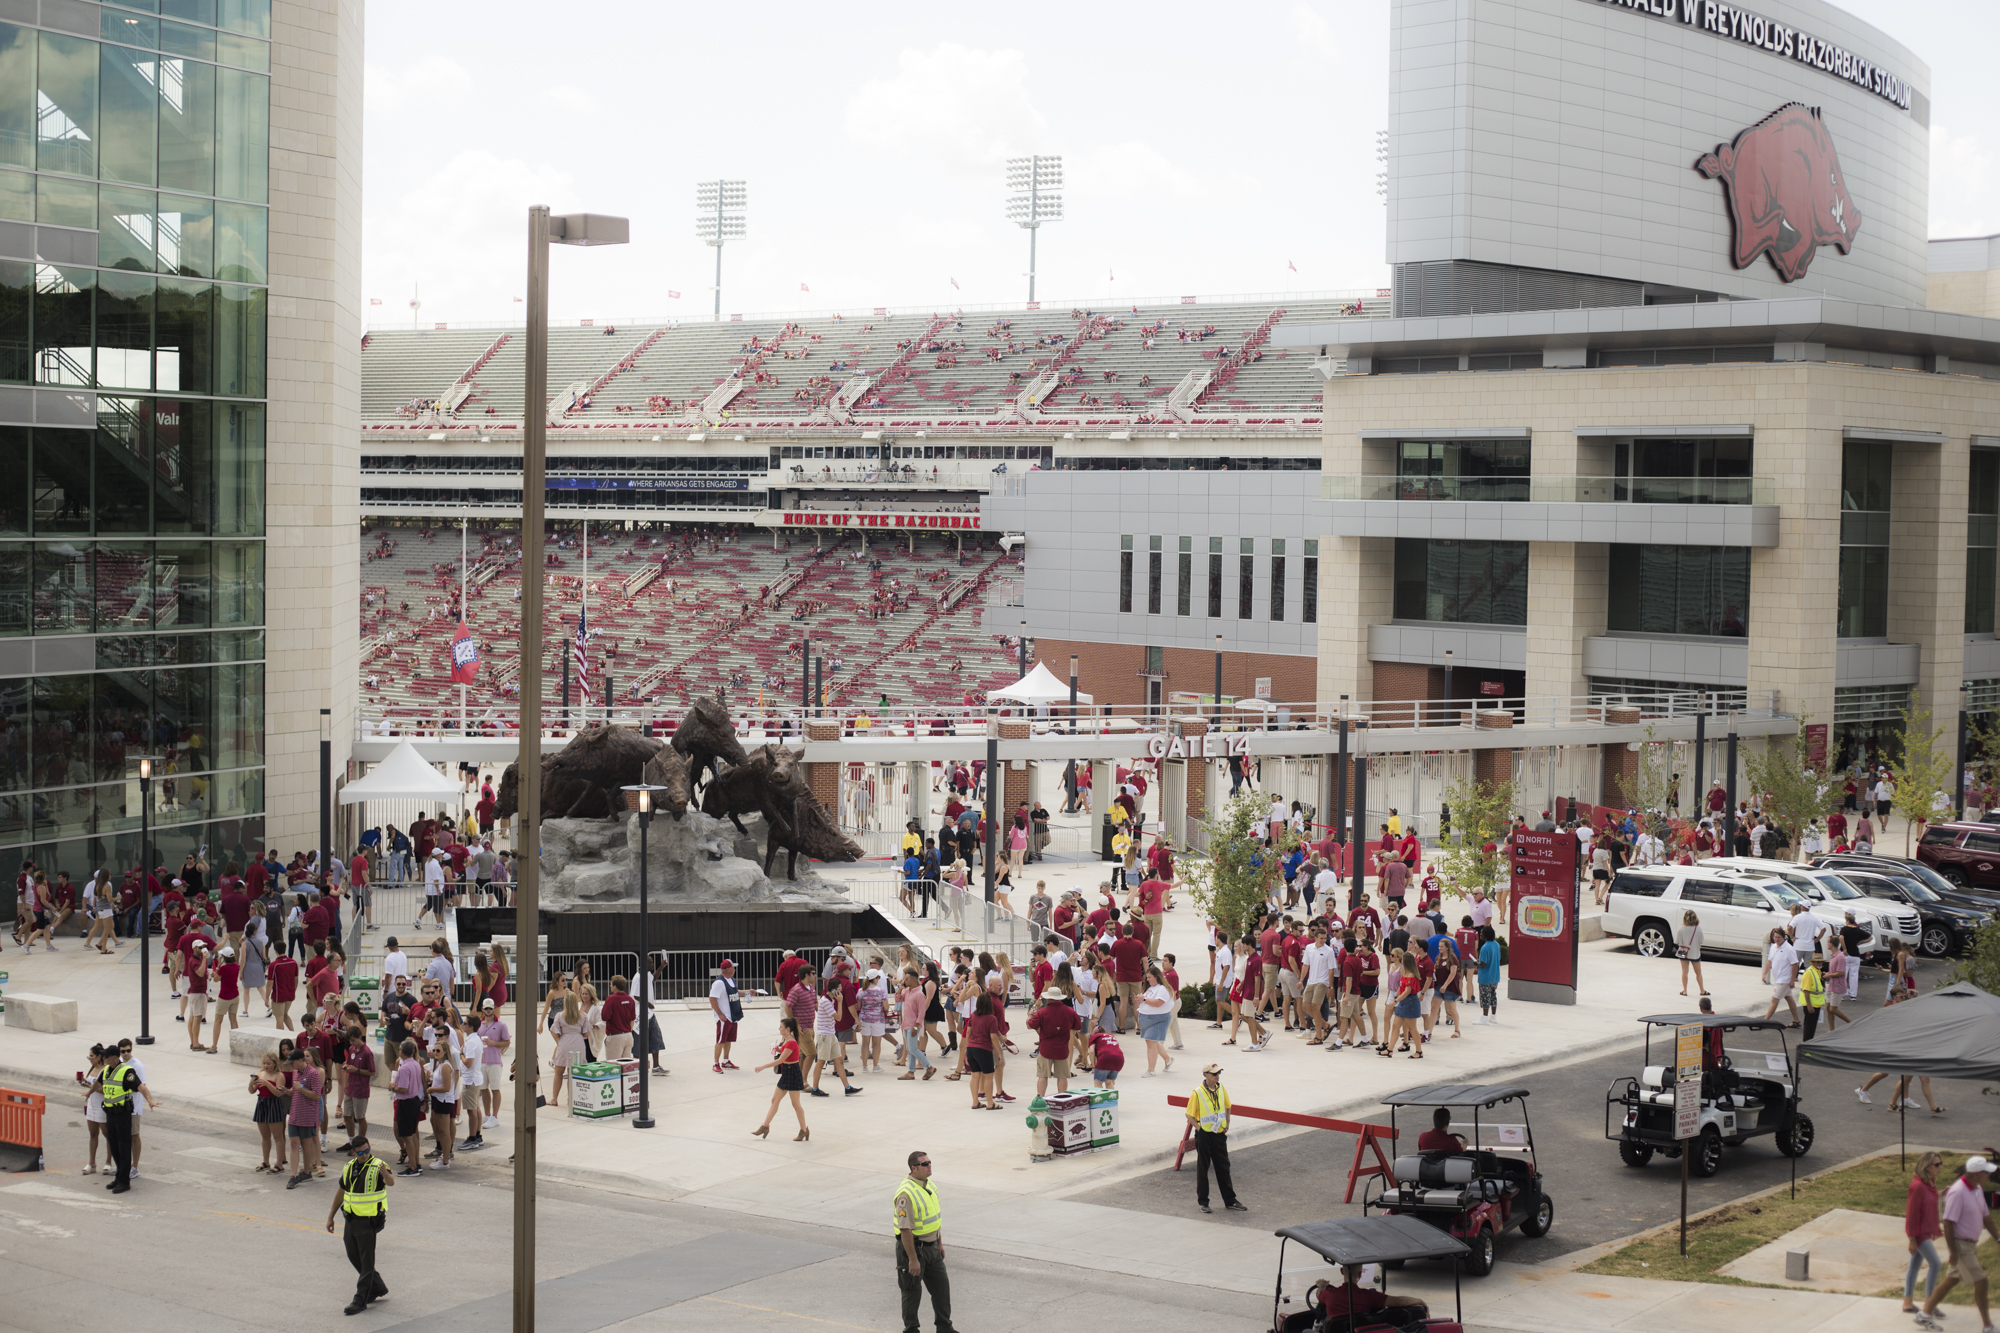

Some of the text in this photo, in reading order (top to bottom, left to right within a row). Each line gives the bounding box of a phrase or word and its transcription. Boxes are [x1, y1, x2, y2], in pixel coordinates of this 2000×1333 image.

[1682, 0, 1699, 25] W
[1704, 1, 1795, 57] REYNOLDS
[1797, 32, 1874, 90] RAZORBACK
[1874, 66, 1912, 111] STADIUM
[631, 480, 738, 488] WHERE ARKANSAS GETS ENGAGED
[783, 513, 828, 525] HOME
[832, 514, 850, 525] OF
[857, 515, 888, 526] THE
[1150, 669, 1169, 677] CLUB
[1149, 735, 1252, 758] GATE 14
[1526, 836, 1552, 845] NORTH
[1539, 849, 1553, 857] 1-12
[1537, 868, 1546, 876] 14
[1427, 882, 1439, 892] 32
[1463, 932, 1468, 945] 1
[1682, 1042, 1699, 1050] PARKING
[576, 1081, 591, 1089] RECYCLE
[573, 1100, 594, 1109] RAZORBACKS
[1679, 1112, 1691, 1120] HEAD
[1678, 1118, 1698, 1128] PARKING
[1099, 1127, 1114, 1135] Recycle
[1682, 1127, 1693, 1135] ONLY
[1068, 1133, 1088, 1142] RAZORBACKS
